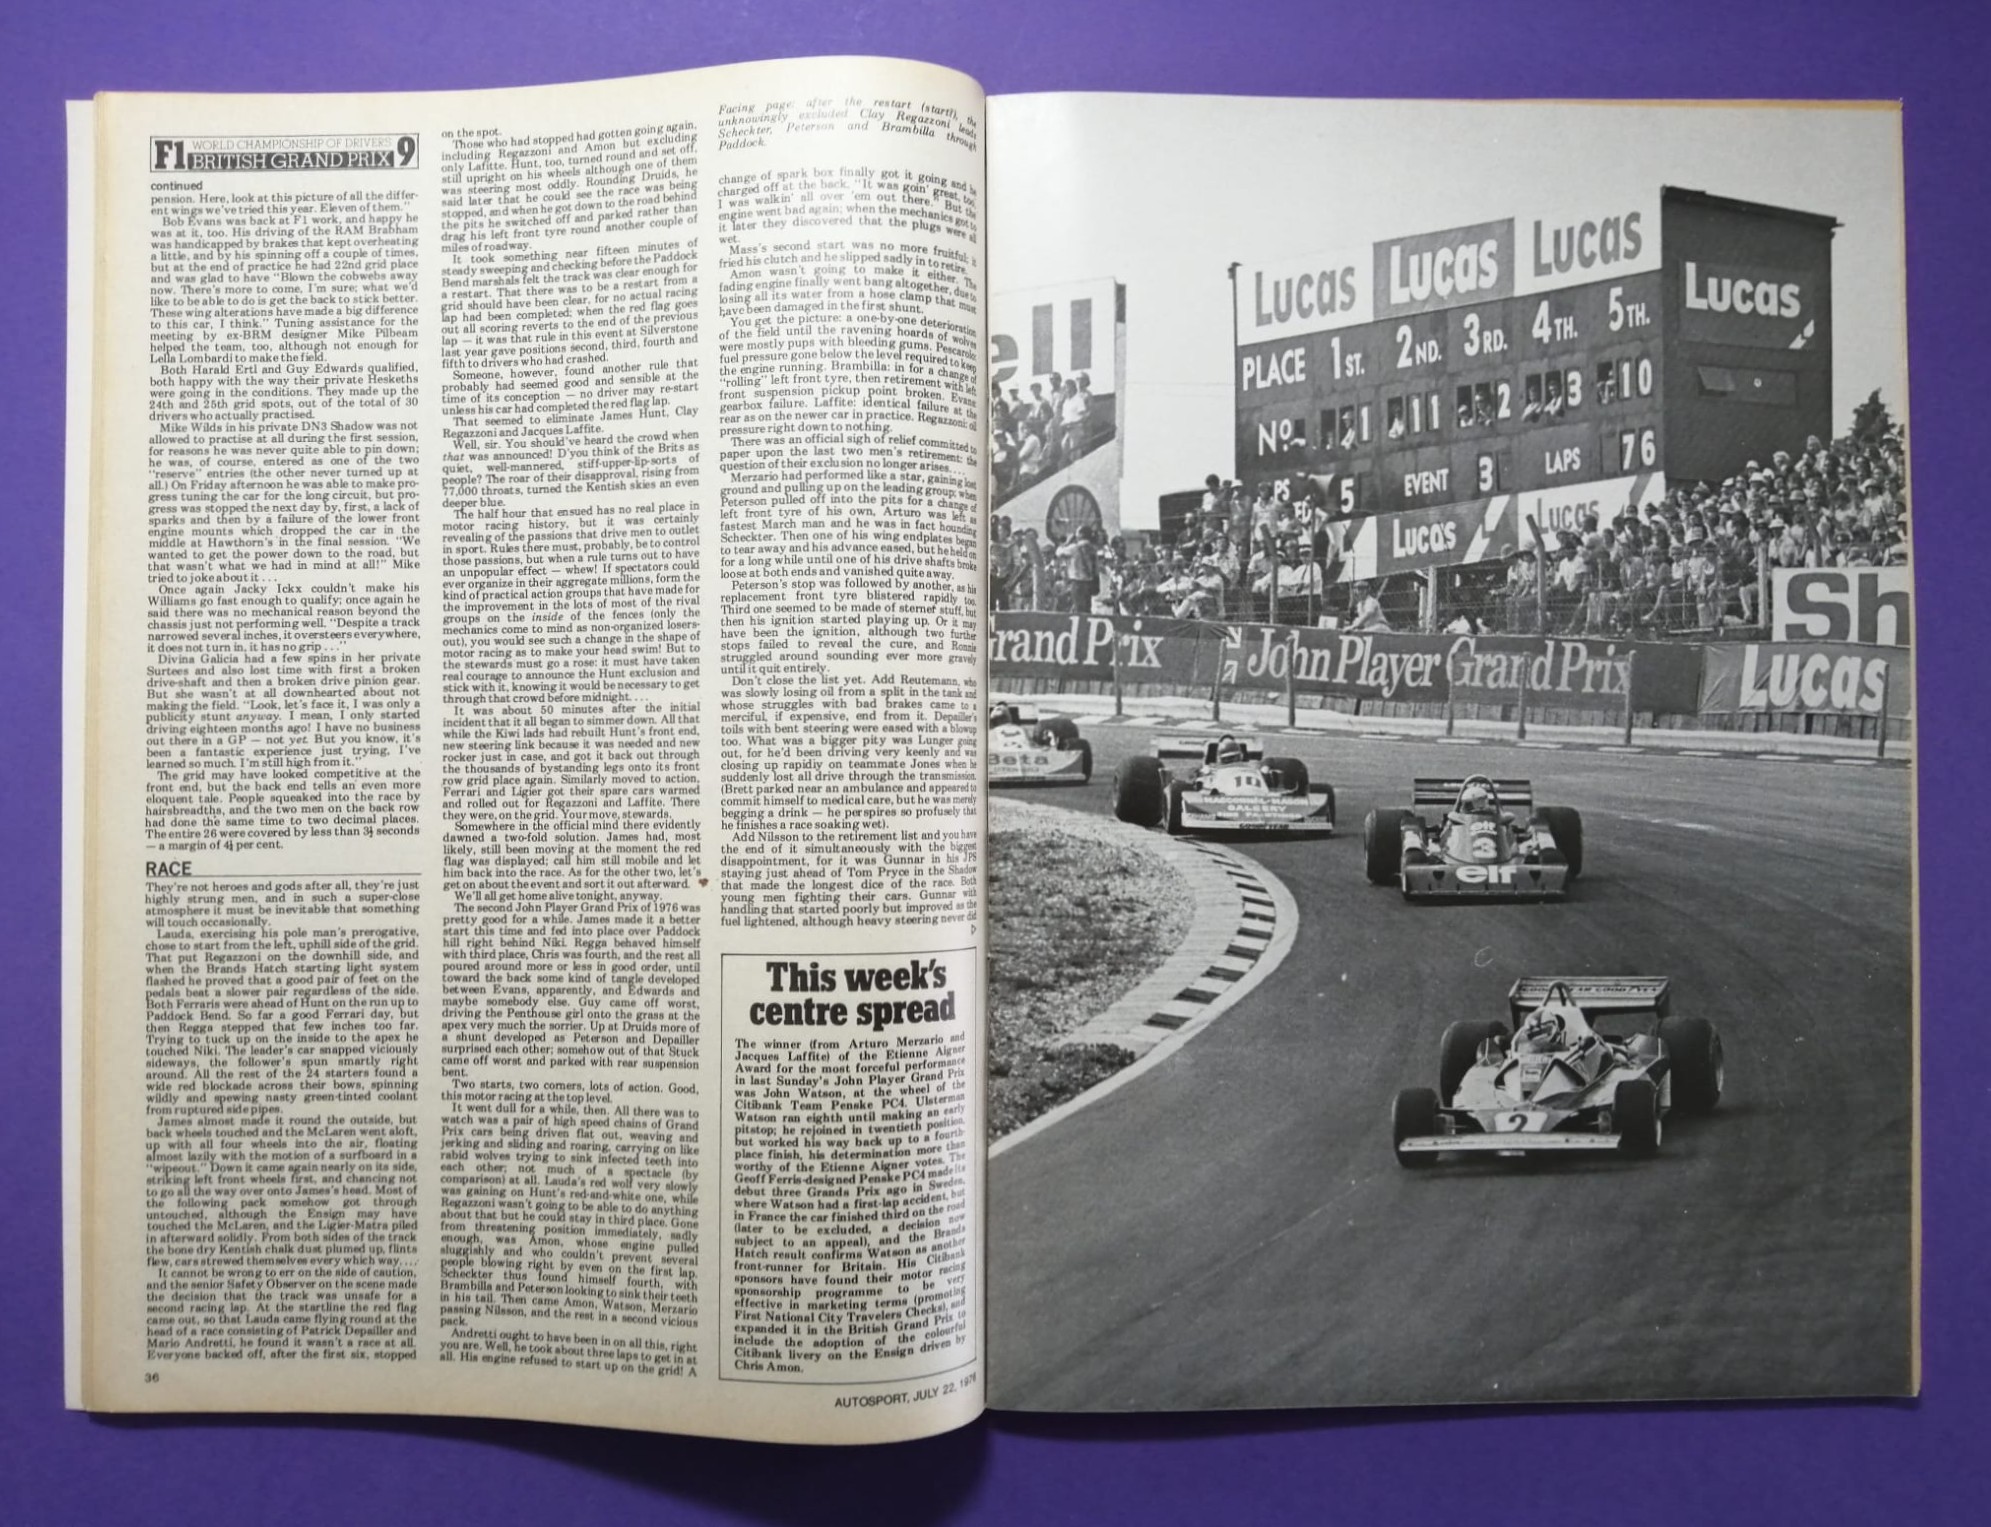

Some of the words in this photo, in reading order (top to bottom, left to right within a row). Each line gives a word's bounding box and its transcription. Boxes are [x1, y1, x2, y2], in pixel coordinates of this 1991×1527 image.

[718, 126, 772, 138] Scheckter,
[786, 122, 834, 132] Peterson
[847, 121, 868, 131] and
[882, 122, 935, 137] Brambilla
[192, 140, 234, 150] WORLD
[237, 139, 322, 150] CHAMPIONSHIP
[326, 138, 342, 149] OF
[346, 137, 392, 148] DRIVERS
[398, 137, 415, 166] 9
[718, 139, 766, 151] Paddock.
[155, 140, 186, 169] F1
[193, 153, 266, 169] BRITISH
[271, 152, 343, 168] GRAND
[348, 152, 393, 167] PRIX
[151, 181, 203, 190] continued
[1255, 266, 1356, 327] Lucas
[1390, 239, 1498, 304] Lucas
[1534, 211, 1642, 277] Lucas
[1685, 261, 1801, 318] Lucas
[150, 331, 193, 341] meeting
[203, 331, 216, 340] by
[227, 330, 271, 339] ex-BRM
[282, 330, 327, 340] designer
[338, 329, 365, 338] Mike
[376, 329, 418, 337] Pilbeam
[453, 370, 503, 380] Someone,
[510, 368, 557, 378] however,
[565, 366, 594, 376] found
[603, 363, 641, 373] another
[649, 361, 668, 370] rule
[676, 358, 698, 368] that
[1243, 347, 1306, 391] PLACE
[1361, 405, 1369, 442] 1
[1412, 394, 1439, 433] 11
[1497, 382, 1511, 419] 2
[1567, 370, 1582, 407] 3
[1621, 358, 1652, 398] 10
[1341, 478, 1354, 513] 5
[1404, 468, 1449, 497] EVENT
[1479, 456, 1493, 491] 3
[1545, 446, 1581, 475] LAPS
[1622, 430, 1656, 470] 76
[1392, 519, 1457, 559] Lucas
[159, 585, 186, 594] Once
[195, 585, 224, 595] again
[234, 584, 266, 595] Jacky
[277, 584, 302, 593] Ickx
[311, 583, 355, 593] couldn't
[366, 583, 394, 592] make
[404, 583, 419, 592] his
[721, 592, 786, 603] replacement
[796, 591, 824, 601] front
[834, 591, 857, 602] tyre
[867, 590, 915, 601] blistered
[924, 592, 957, 606] rapidly
[1083, 617, 1165, 668] Prix
[1247, 627, 1332, 680] John
[1336, 635, 1441, 699] Player
[1446, 636, 1553, 691] Grand
[1560, 642, 1633, 695] Prix
[1739, 644, 1889, 713] Lucas
[454, 706, 464, 715] It
[473, 707, 493, 715] was
[502, 706, 532, 715] about
[541, 705, 554, 714] 50
[562, 704, 604, 714] minutes
[612, 703, 635, 713] after
[645, 703, 662, 712] the
[670, 702, 700, 711] initial
[1472, 837, 1497, 859] 3
[146, 860, 192, 876] RACE
[1456, 865, 1517, 884] elf
[721, 893, 754, 904] young
[763, 894, 785, 902] men
[795, 891, 840, 904] fighting
[849, 891, 876, 901] their
[885, 892, 911, 901] cars.
[920, 890, 956, 900] Gunnar
[962, 888, 977, 897] with
[767, 961, 836, 992] This
[844, 959, 947, 992] week's
[442, 998, 478, 1008] maybe
[487, 998, 538, 1009] somebody
[548, 998, 570, 1007] else.
[579, 998, 600, 1009] Guy
[645, 998, 659, 1008] off
[668, 1000, 700, 1010] worst,
[750, 998, 847, 1025] centre
[856, 991, 955, 1031] spread
[735, 1039, 756, 1049] The
[764, 1040, 801, 1049] winner
[810, 1040, 840, 1050] (from
[850, 1039, 888, 1049] Arturo
[896, 1036, 943, 1048] Merzario
[950, 1031, 965, 1042] and
[146, 1058, 200, 1069] sideways,
[210, 1058, 227, 1067] the
[238, 1057, 291, 1067] follower's
[301, 1058, 328, 1068] spun
[338, 1057, 380, 1068] smartly
[391, 1056, 418, 1068] right
[735, 1100, 782, 1110] Citibank
[791, 1100, 822, 1110] Team
[831, 1100, 873, 1110] Penske
[881, 1099, 908, 1108] PC4.
[916, 1093, 965, 1107] Ulsterman
[1508, 1114, 1528, 1133] 2
[146, 1199, 164, 1208] the
[177, 1198, 227, 1209] following
[241, 1198, 266, 1209] pack
[280, 1198, 329, 1207] somehow
[343, 1199, 361, 1209] got
[374, 1198, 417, 1209] through
[441, 1234, 483, 1245] enough,
[496, 1237, 516, 1245] was
[529, 1237, 563, 1248] Amon,
[576, 1239, 608, 1249] whose
[620, 1241, 655, 1251] engine
[667, 1243, 699, 1254] pulled
[734, 1287, 801, 1299] sponsorship
[816, 1288, 883, 1299] programme
[898, 1284, 909, 1294] to
[923, 1280, 935, 1290] be
[947, 1274, 966, 1285] very
[734, 1361, 764, 1371] Chris
[767, 1362, 804, 1373] Amon.
[145, 1373, 160, 1383] 36
[835, 1392, 910, 1408] AUTOSPORT,
[913, 1386, 939, 1402] JULY
